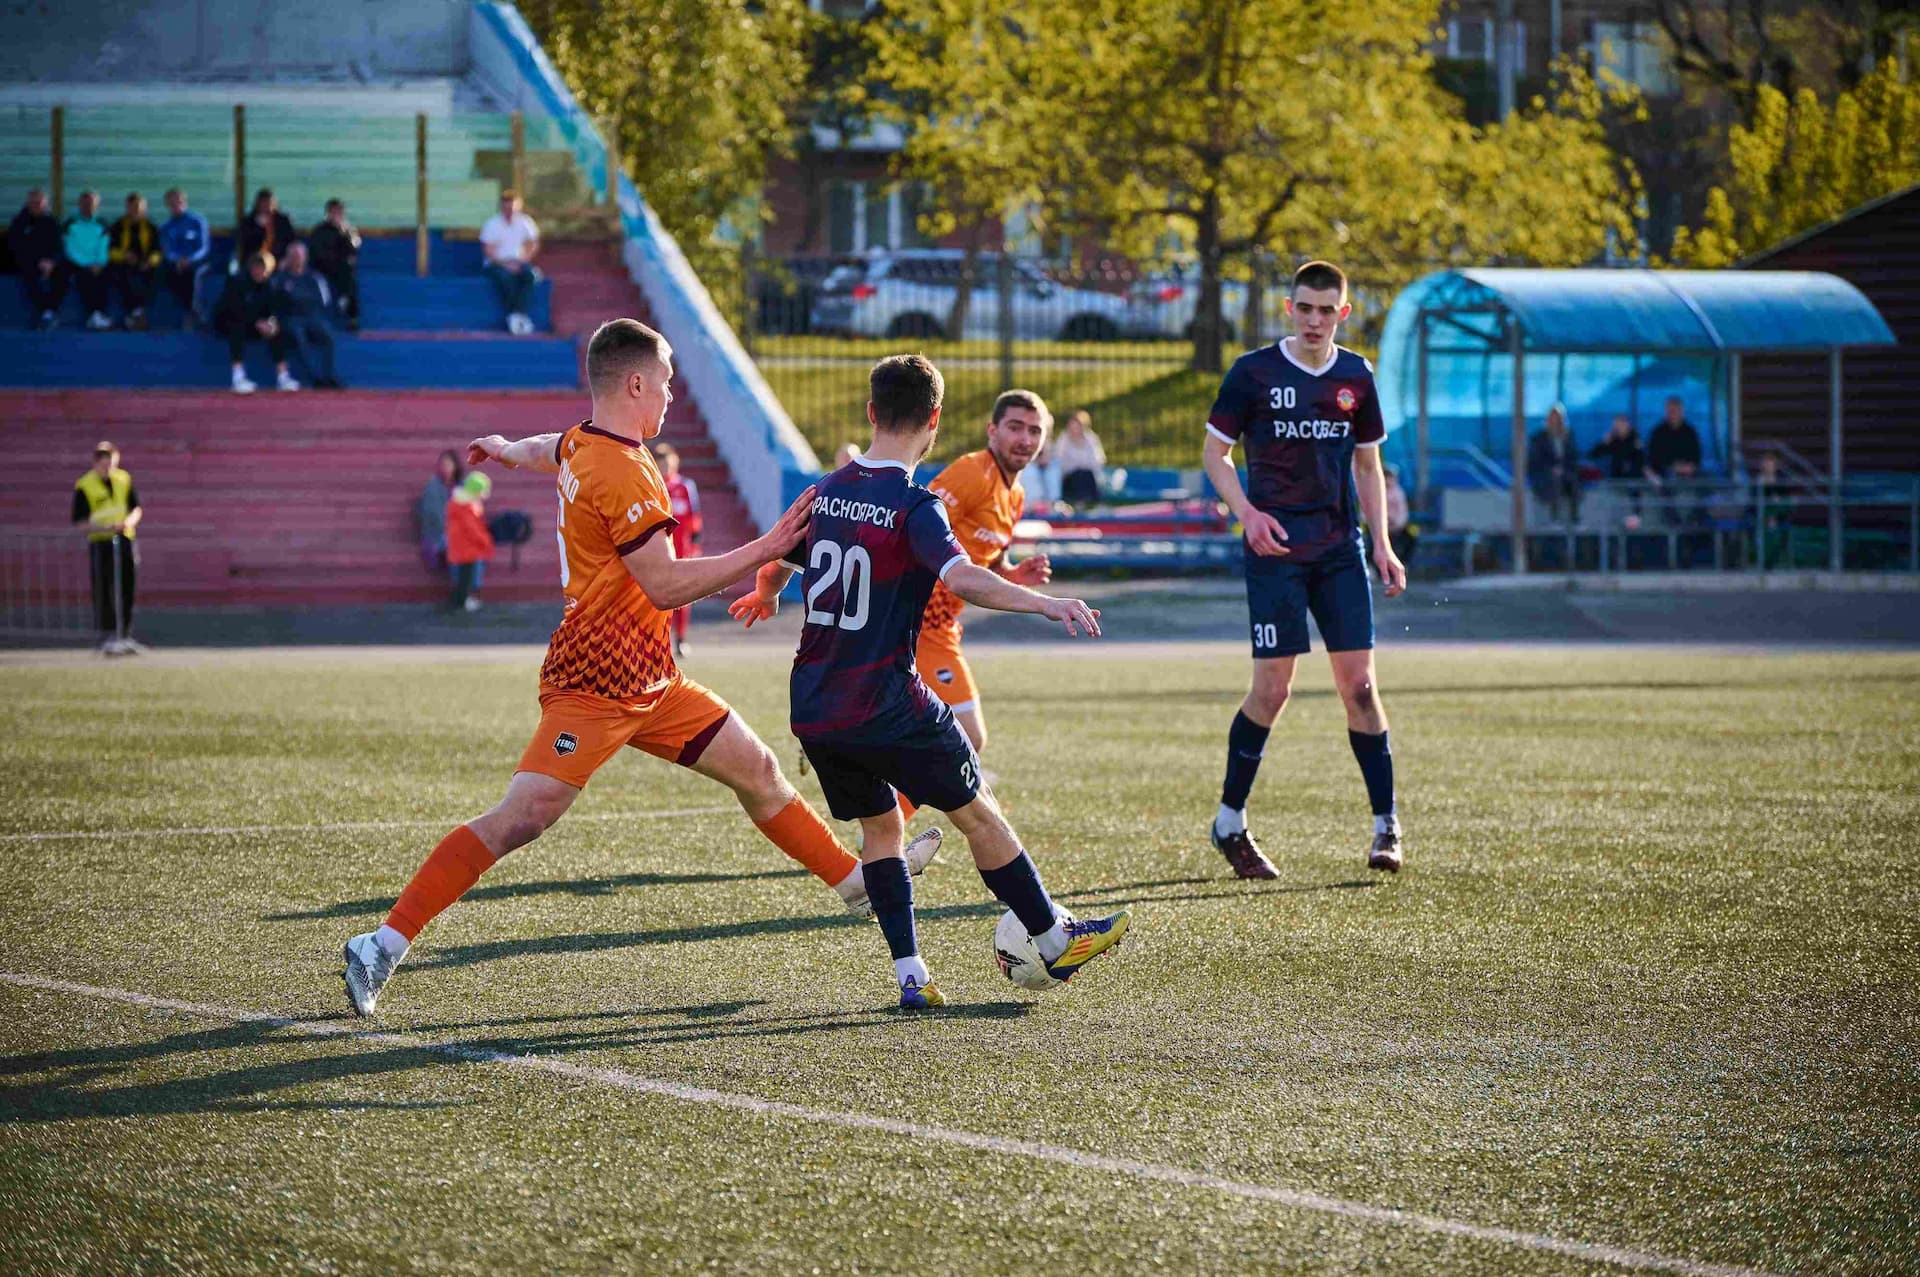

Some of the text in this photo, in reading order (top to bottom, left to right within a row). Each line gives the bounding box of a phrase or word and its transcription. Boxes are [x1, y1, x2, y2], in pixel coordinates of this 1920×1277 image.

[1269, 386, 1296, 409] 30
[806, 539, 871, 631] 20
[1254, 623, 1278, 648] 30
